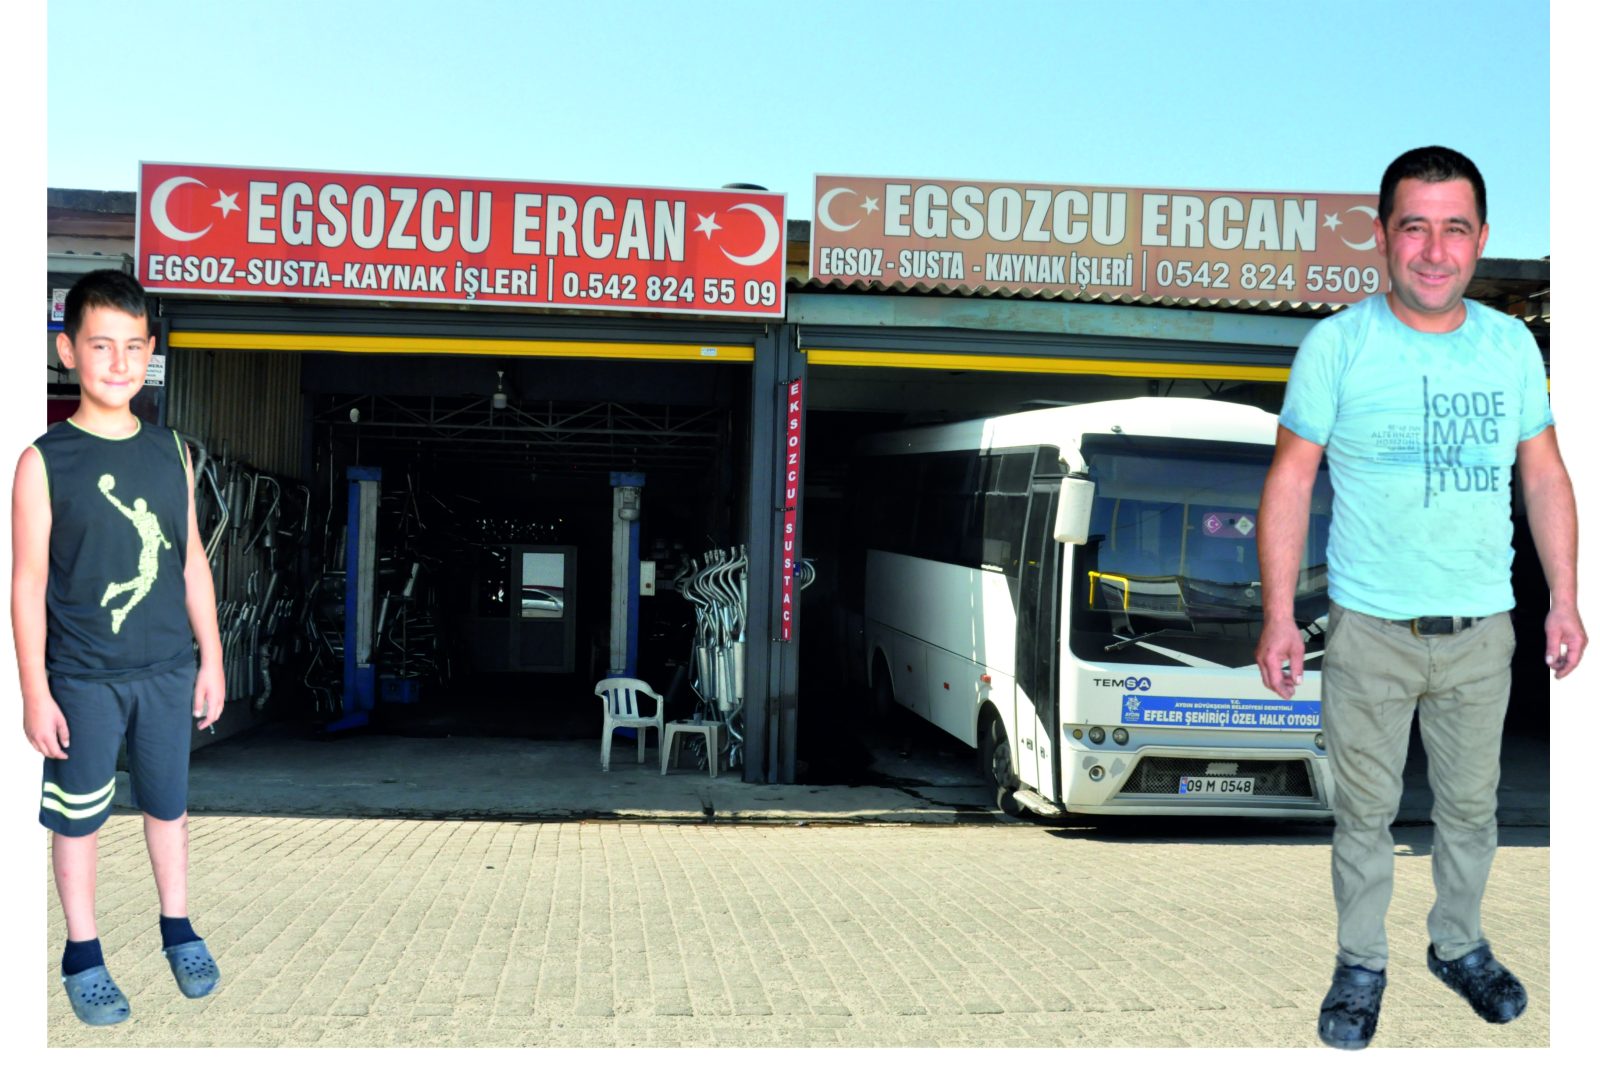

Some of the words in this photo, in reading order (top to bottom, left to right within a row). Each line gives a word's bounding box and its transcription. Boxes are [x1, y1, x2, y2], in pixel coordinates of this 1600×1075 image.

[247, 180, 493, 254] EGSOZCU
[512, 192, 686, 262] ERCAN
[884, 183, 1127, 246] EGSOZCU
[1141, 193, 1318, 252] ERCAN
[454, 260, 537, 300] İŞLERİ
[562, 271, 638, 300] 0.542
[646, 275, 694, 303] 824
[703, 278, 736, 304] 55
[744, 280, 777, 307] 09
[819, 247, 884, 277] EGSOZ
[899, 249, 965, 280] SUSTA
[985, 252, 1067, 284] KAYNAK
[1070, 251, 1133, 290] İŞLERİ
[1156, 259, 1230, 289] 0542
[1240, 262, 1296, 291] 824
[1305, 265, 1380, 294] 5509
[1432, 391, 1506, 418] CODE
[787, 383, 799, 499] EKSOZCU
[1432, 417, 1499, 445] MAG
[1432, 466, 1501, 492] TUDE
[783, 523, 793, 638] SUSTACI
[1093, 677, 1151, 690] TEMSA
[1143, 709, 1183, 723] EFELER
[1185, 709, 1230, 727] ŞEHİRİÇİ
[1231, 710, 1257, 725] ÖZEL
[1259, 713, 1286, 726] HALK
[1186, 779, 1203, 792] 09
[1206, 780, 1216, 792] M
[1220, 780, 1252, 793] 0548
